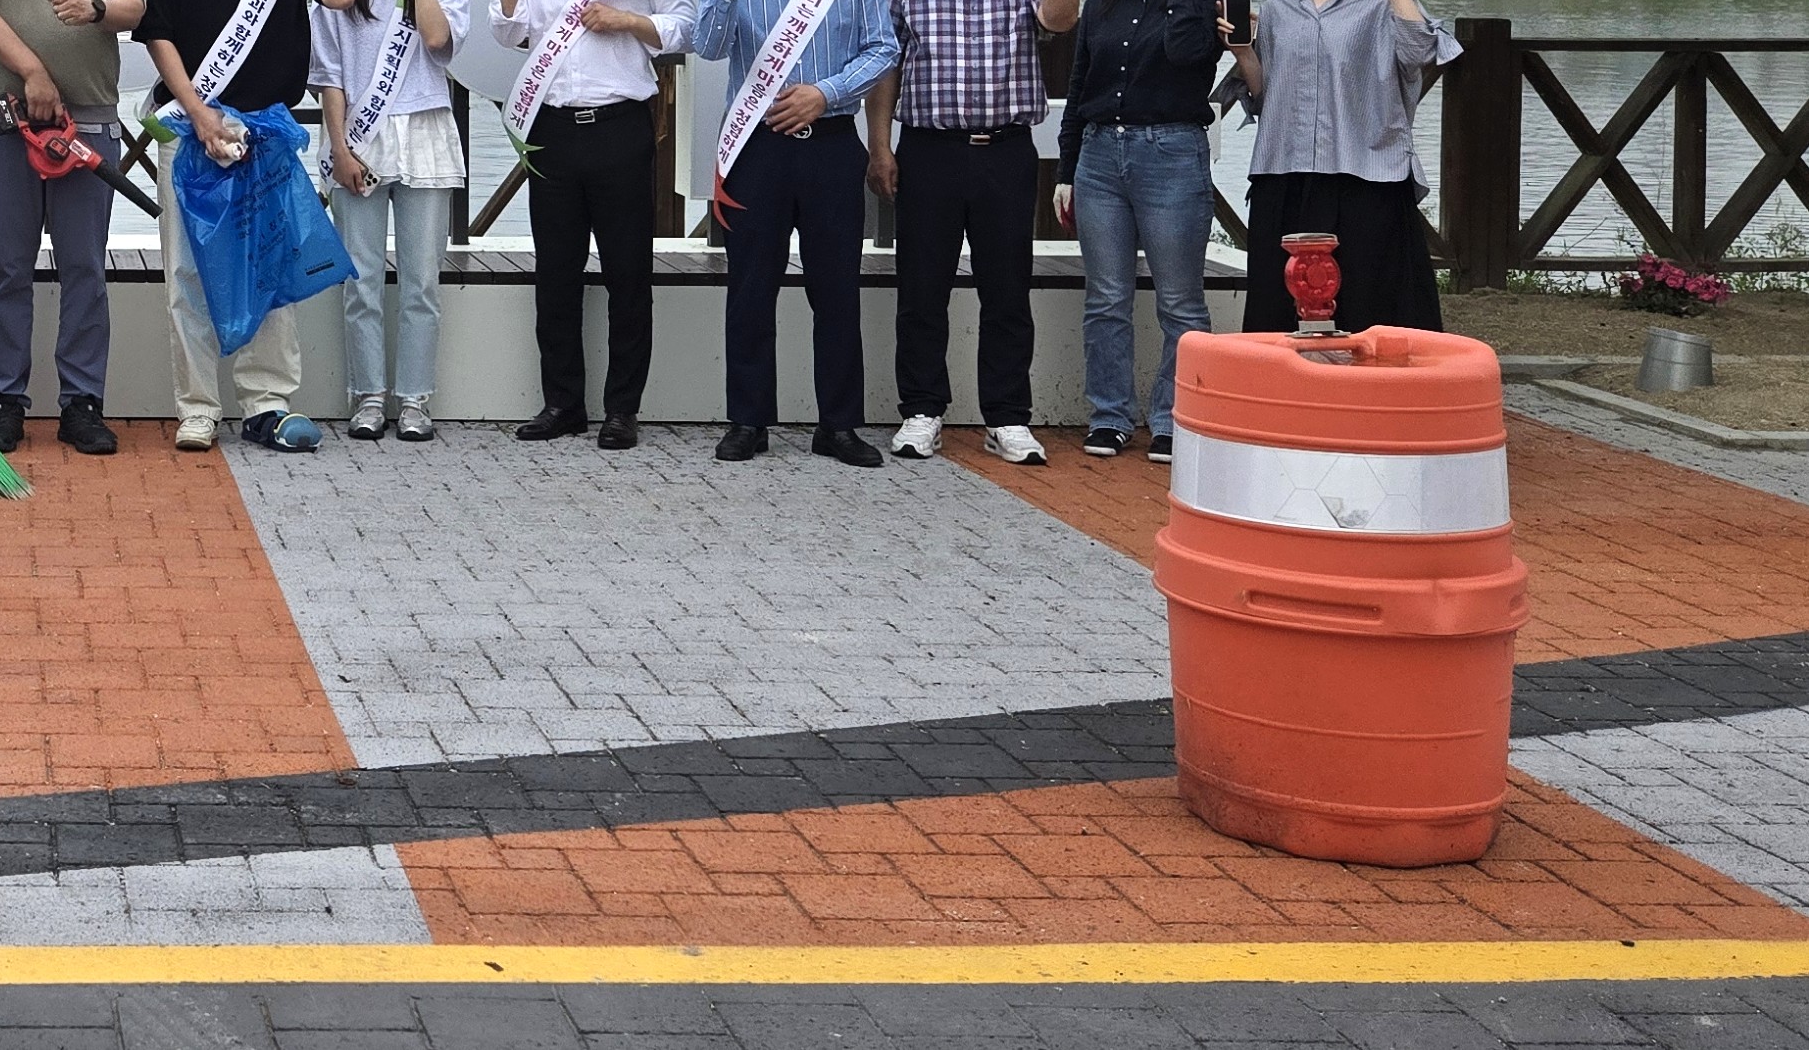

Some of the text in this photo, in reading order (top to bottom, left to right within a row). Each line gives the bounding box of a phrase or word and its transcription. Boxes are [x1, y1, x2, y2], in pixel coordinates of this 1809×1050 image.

[208, 22, 252, 79] 함께하는
[530, 40, 562, 80] 마음은
[509, 78, 540, 131] 청렴하게
[744, 68, 776, 110] 마음은
[347, 93, 387, 144] 함께하는
[718, 109, 752, 165] 청렴하게
